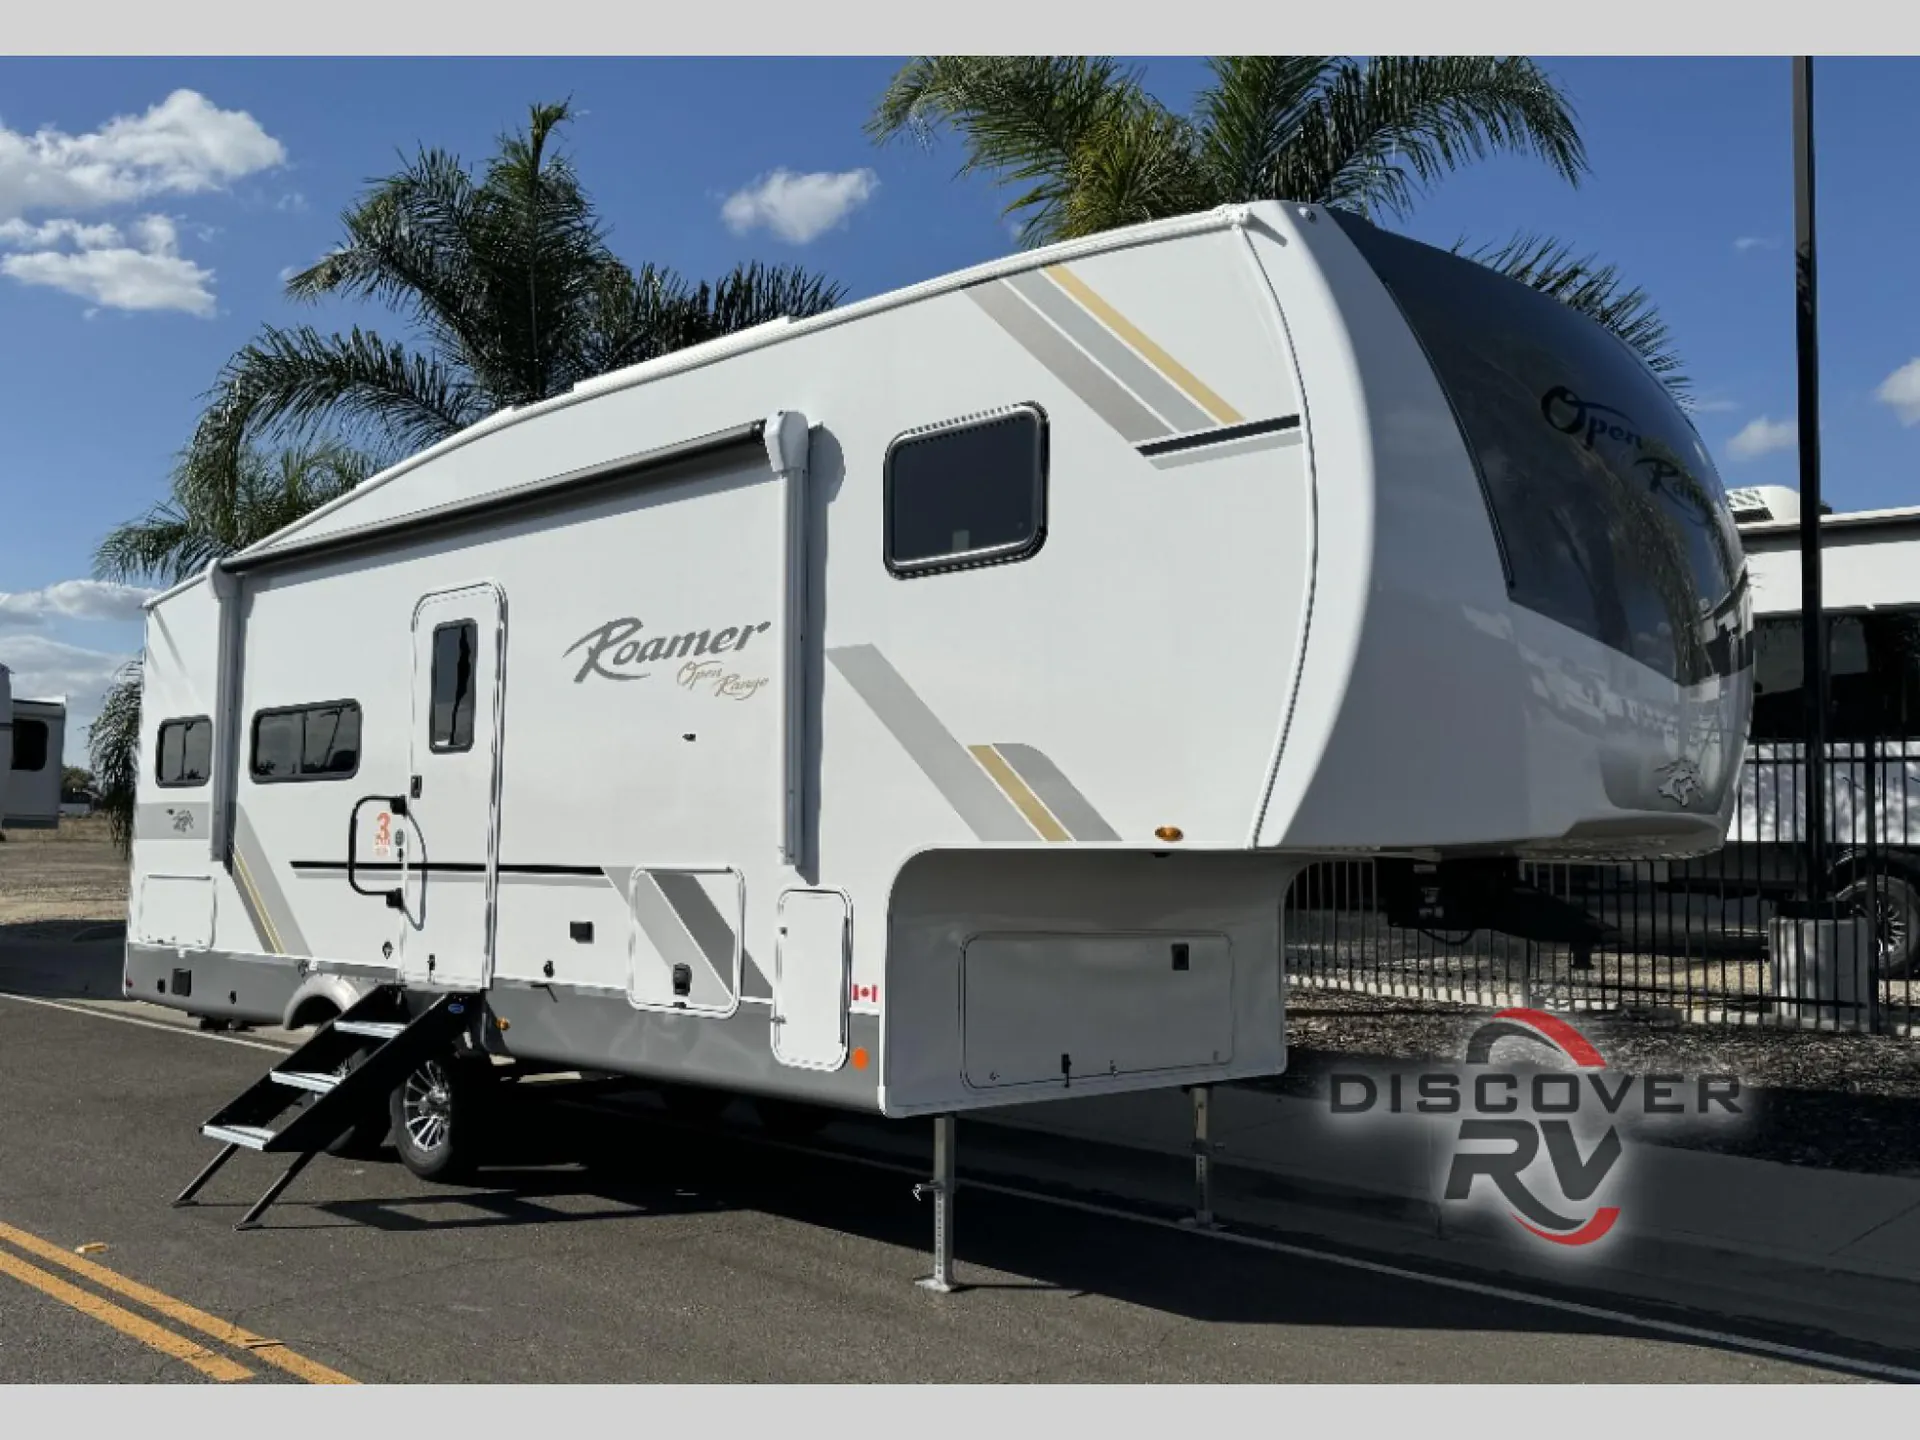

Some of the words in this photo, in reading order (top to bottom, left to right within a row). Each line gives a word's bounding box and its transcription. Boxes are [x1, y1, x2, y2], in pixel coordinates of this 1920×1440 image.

[1541, 385, 1643, 450] Open
[562, 616, 772, 684] Roamer
[676, 660, 725, 691] Open
